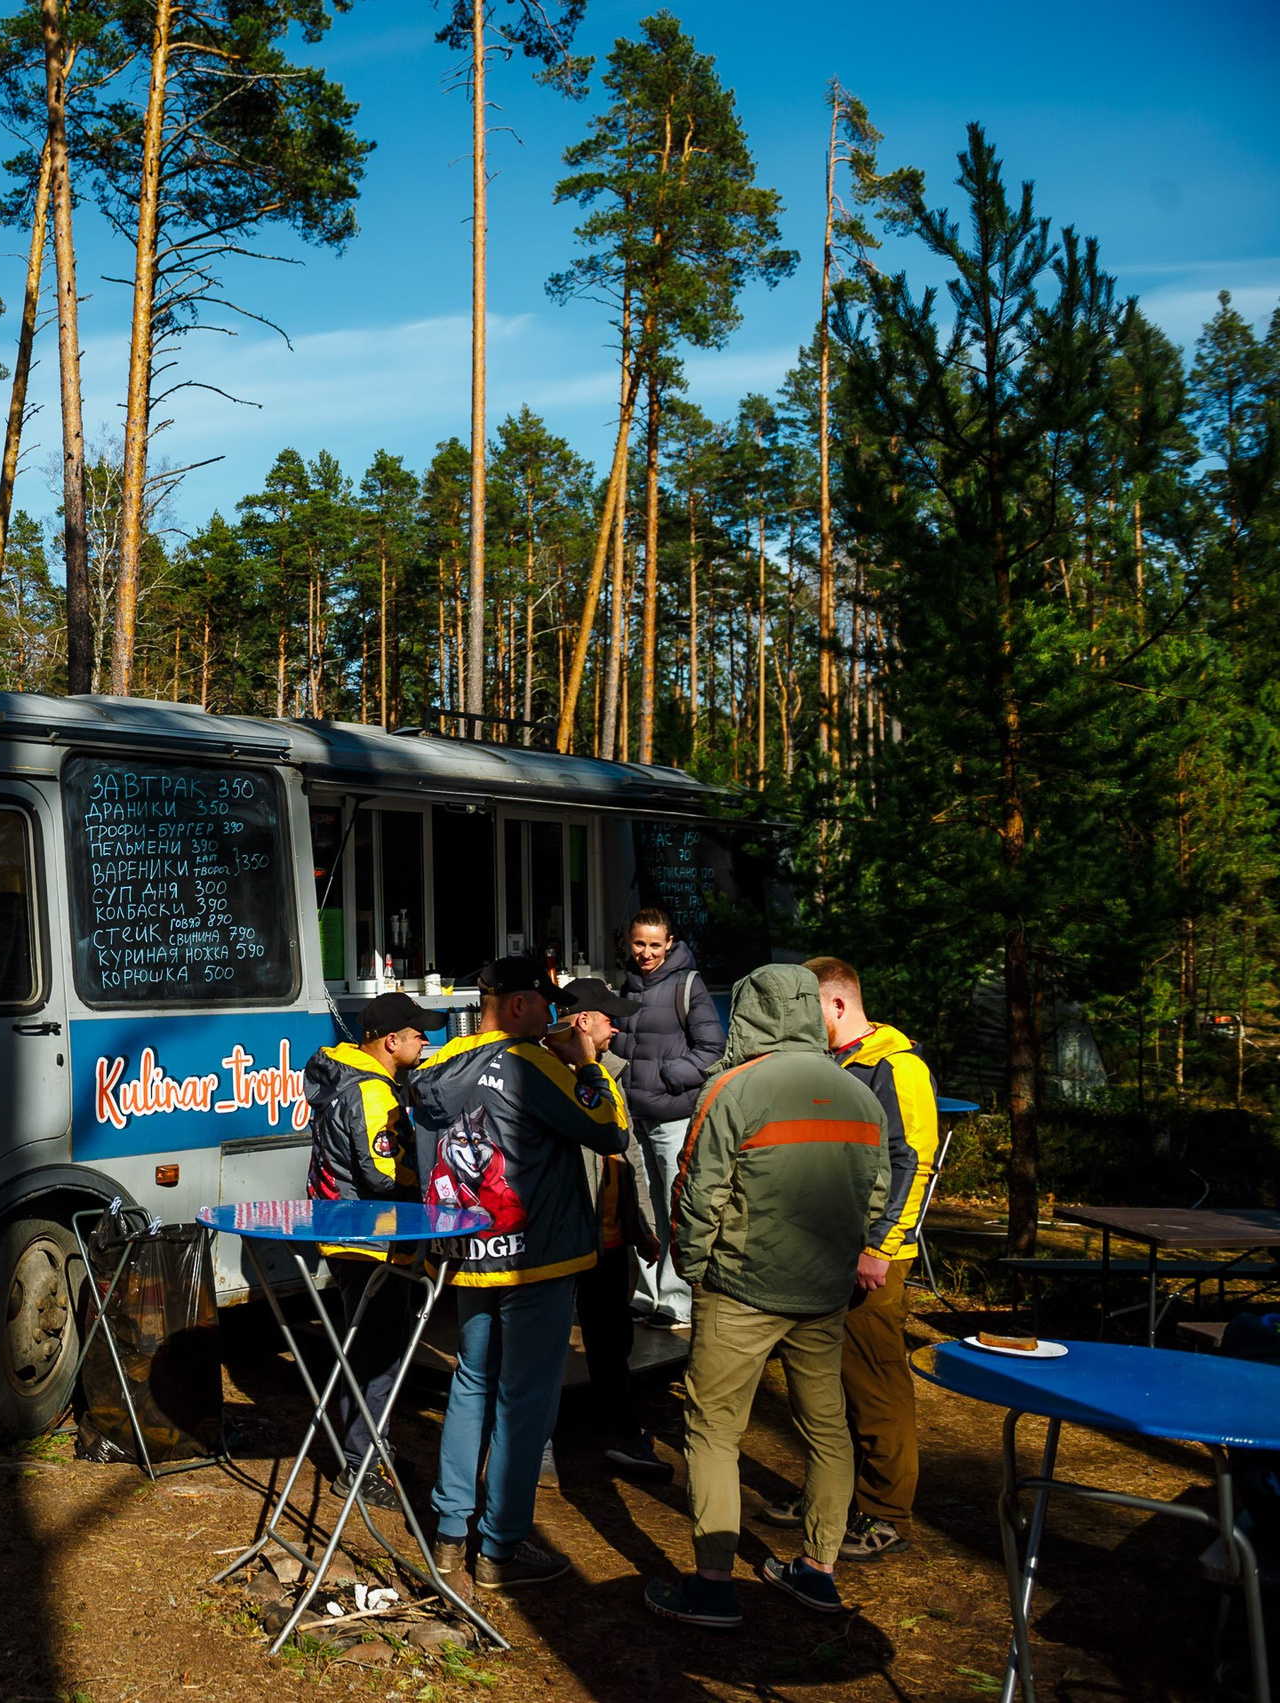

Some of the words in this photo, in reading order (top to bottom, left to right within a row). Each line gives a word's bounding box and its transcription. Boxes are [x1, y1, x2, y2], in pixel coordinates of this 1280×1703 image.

[90, 773, 207, 800] ЗАВТРАК
[218, 778, 255, 799] 350
[85, 801, 177, 825] ДРАНИКИ
[197, 800, 229, 816] 350
[85, 822, 215, 843] ТРОФИ-БУРГЕР
[223, 821, 244, 834] 390
[91, 840, 182, 858] ПЕЛЬМЕНИ
[191, 839, 218, 853] 390
[92, 859, 189, 886] ВАРЕНИКИ
[242, 853, 270, 870] 350
[92, 886, 133, 905] СУП
[141, 882, 178, 901] ДНЯ
[195, 880, 228, 897] 300
[658, 880, 696, 894] ПУЧИНО
[96, 903, 185, 924] КОЛБАСКИ
[197, 898, 228, 916] 390
[207, 913, 233, 927] 890
[169, 929, 220, 946] СВИНИНА
[229, 926, 256, 941] 790
[98, 947, 179, 969] КУРИНАЯ
[185, 945, 229, 964] НОЖКА
[236, 942, 265, 958] 590
[102, 966, 189, 989] КОРЮШКА
[205, 965, 235, 982] 500
[95, 1038, 312, 1130] Kulinar_trophy
